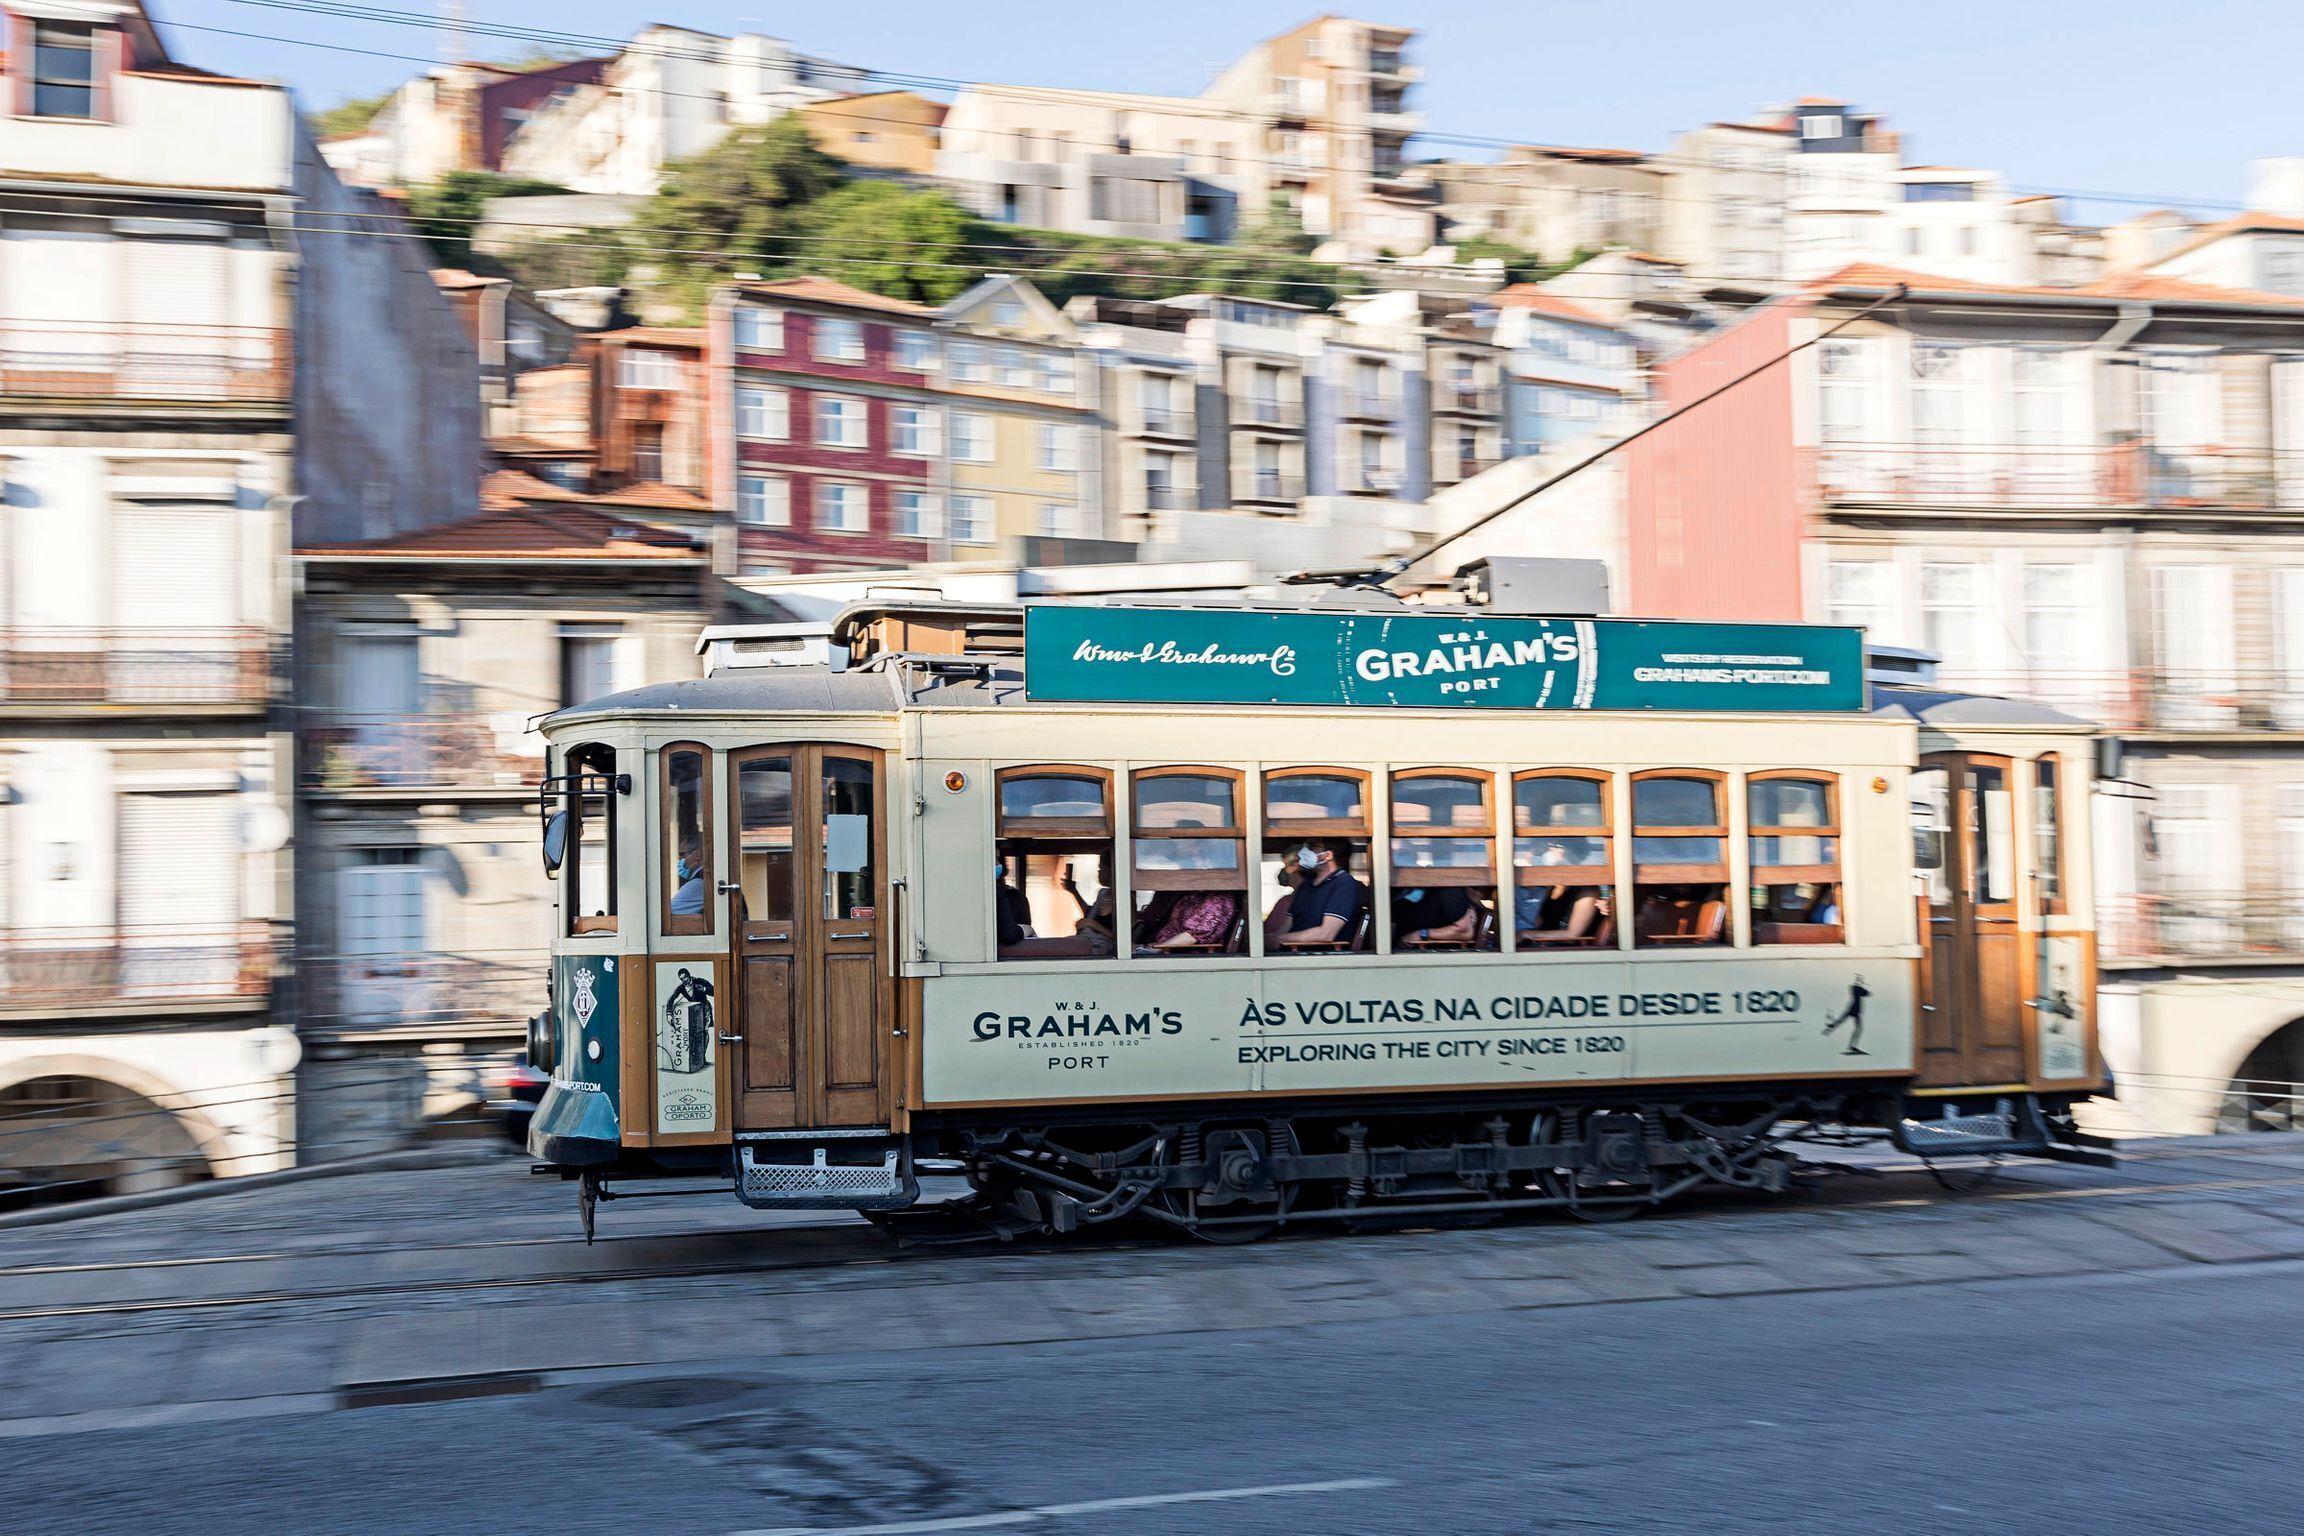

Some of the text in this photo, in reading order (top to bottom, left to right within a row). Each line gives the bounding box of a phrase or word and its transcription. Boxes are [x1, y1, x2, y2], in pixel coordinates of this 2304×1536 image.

[1356, 633, 1578, 682] GRAHAM'S
[1441, 677, 1500, 694] PORT
[1055, 1001, 1100, 1011] W. & J.
[1240, 989, 1801, 1026] ÀS VOLTAS NA CIDADE DESDE 1820
[973, 1007, 1182, 1040] GRAHAM'S
[1018, 1039, 1140, 1049] ESTABLISHED 1820
[1238, 1035, 1625, 1063] EXPLORING THE CITY SINCE 1820
[1048, 1056, 1109, 1070] PORT
[671, 1112, 706, 1120] OPORTO
